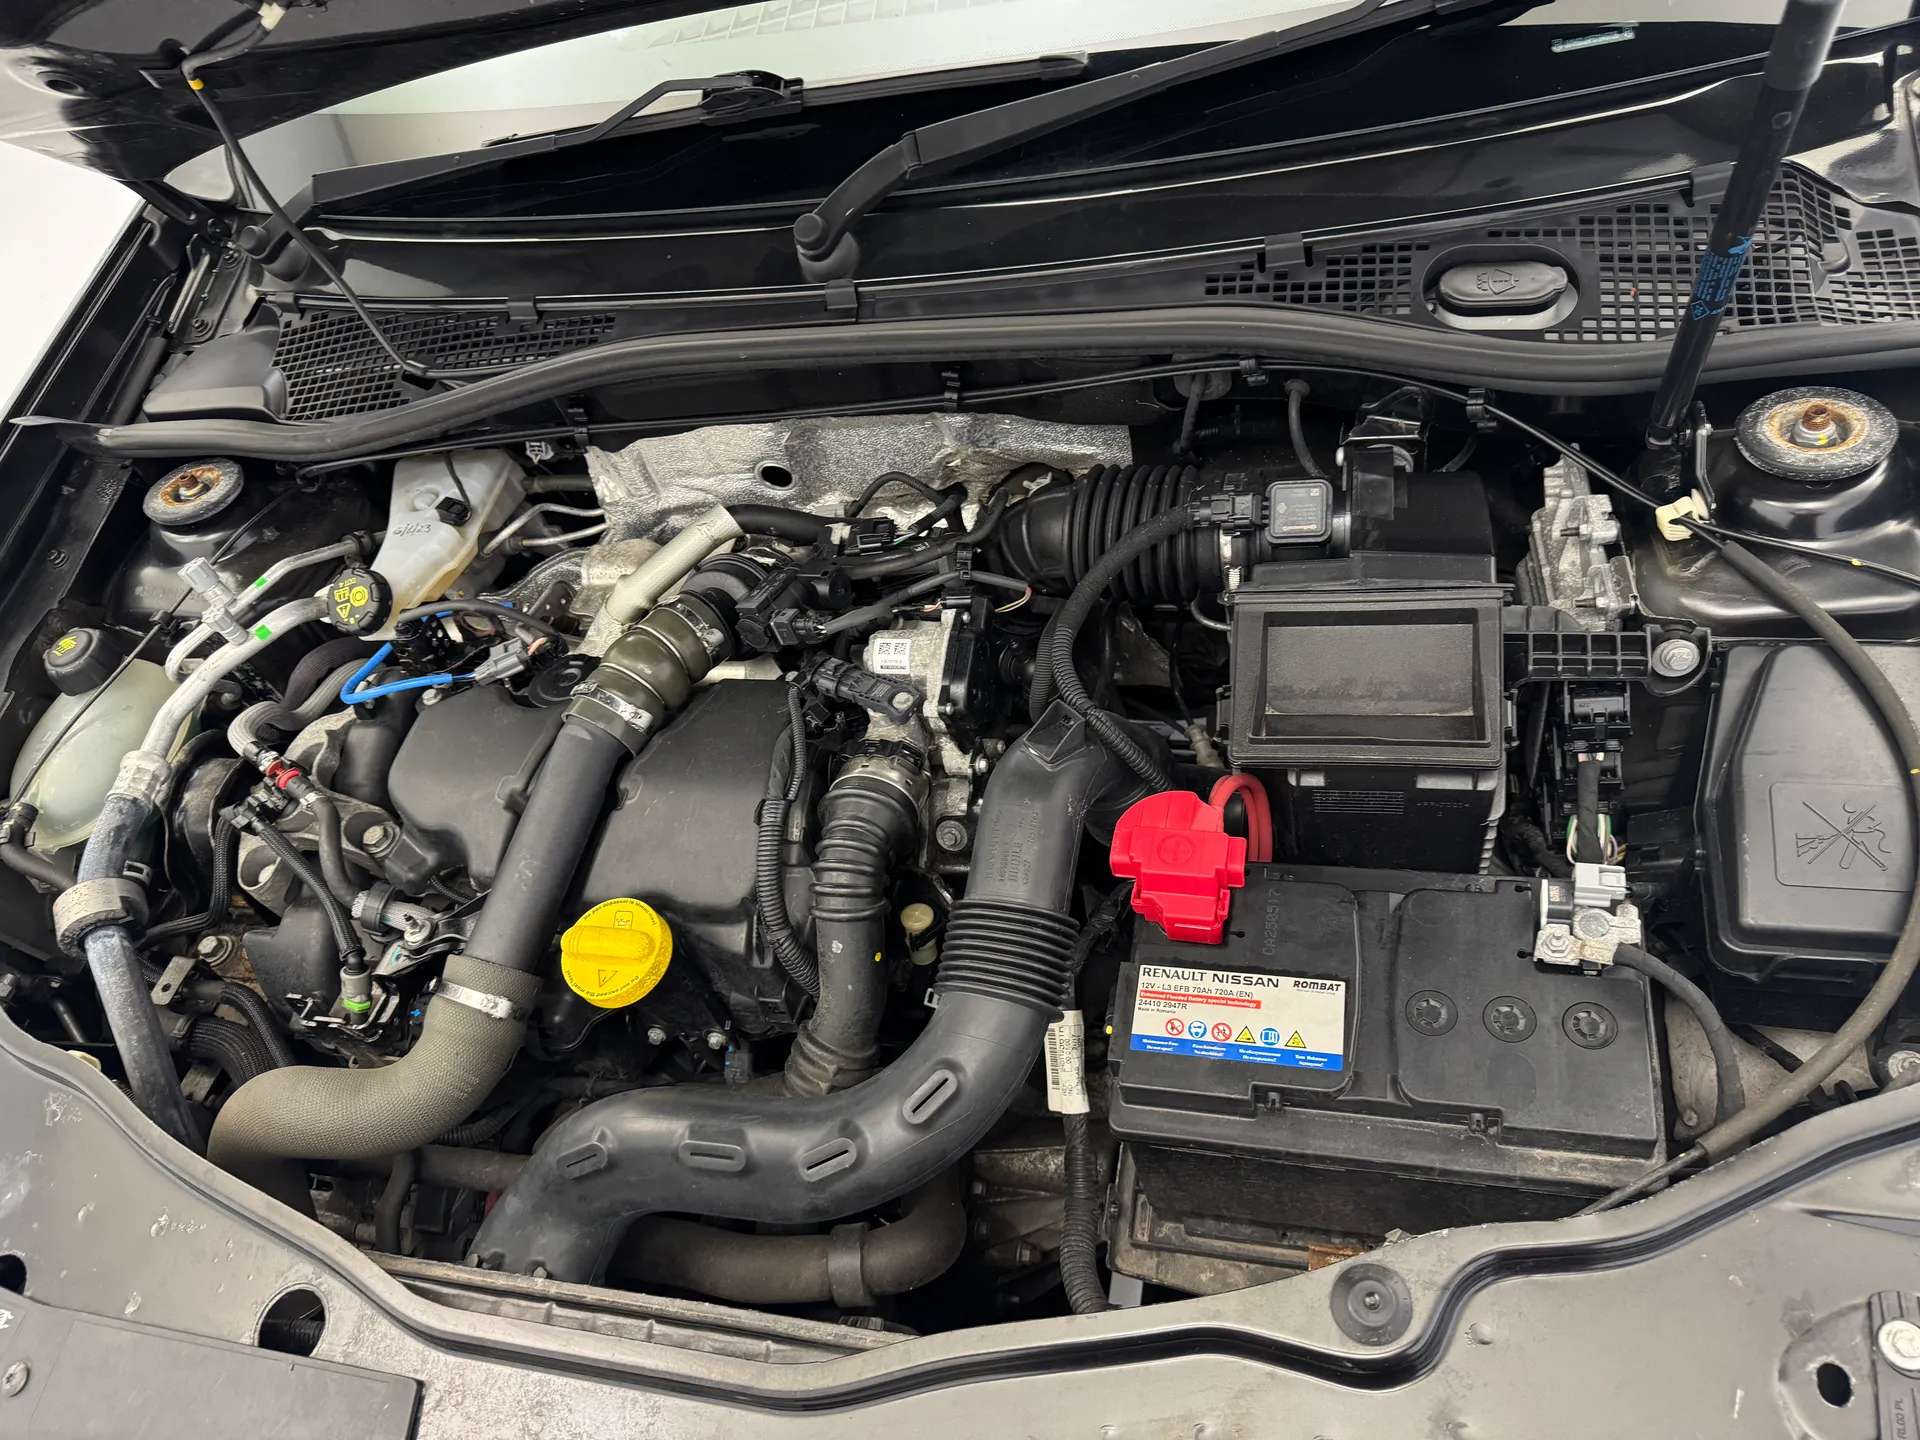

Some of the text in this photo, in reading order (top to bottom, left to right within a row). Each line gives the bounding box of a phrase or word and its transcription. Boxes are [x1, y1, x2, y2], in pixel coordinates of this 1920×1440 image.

[1142, 967, 1279, 988] RENAULT NISSAN
[1162, 983, 1172, 991] L3
[1174, 985, 1190, 993] EFB
[1192, 986, 1212, 995] 70Ah
[1214, 988, 1234, 996] 720A
[1235, 990, 1254, 1000] (EN)
[1293, 980, 1342, 992] ROMBAT
[1138, 999, 1161, 1007] 24410
